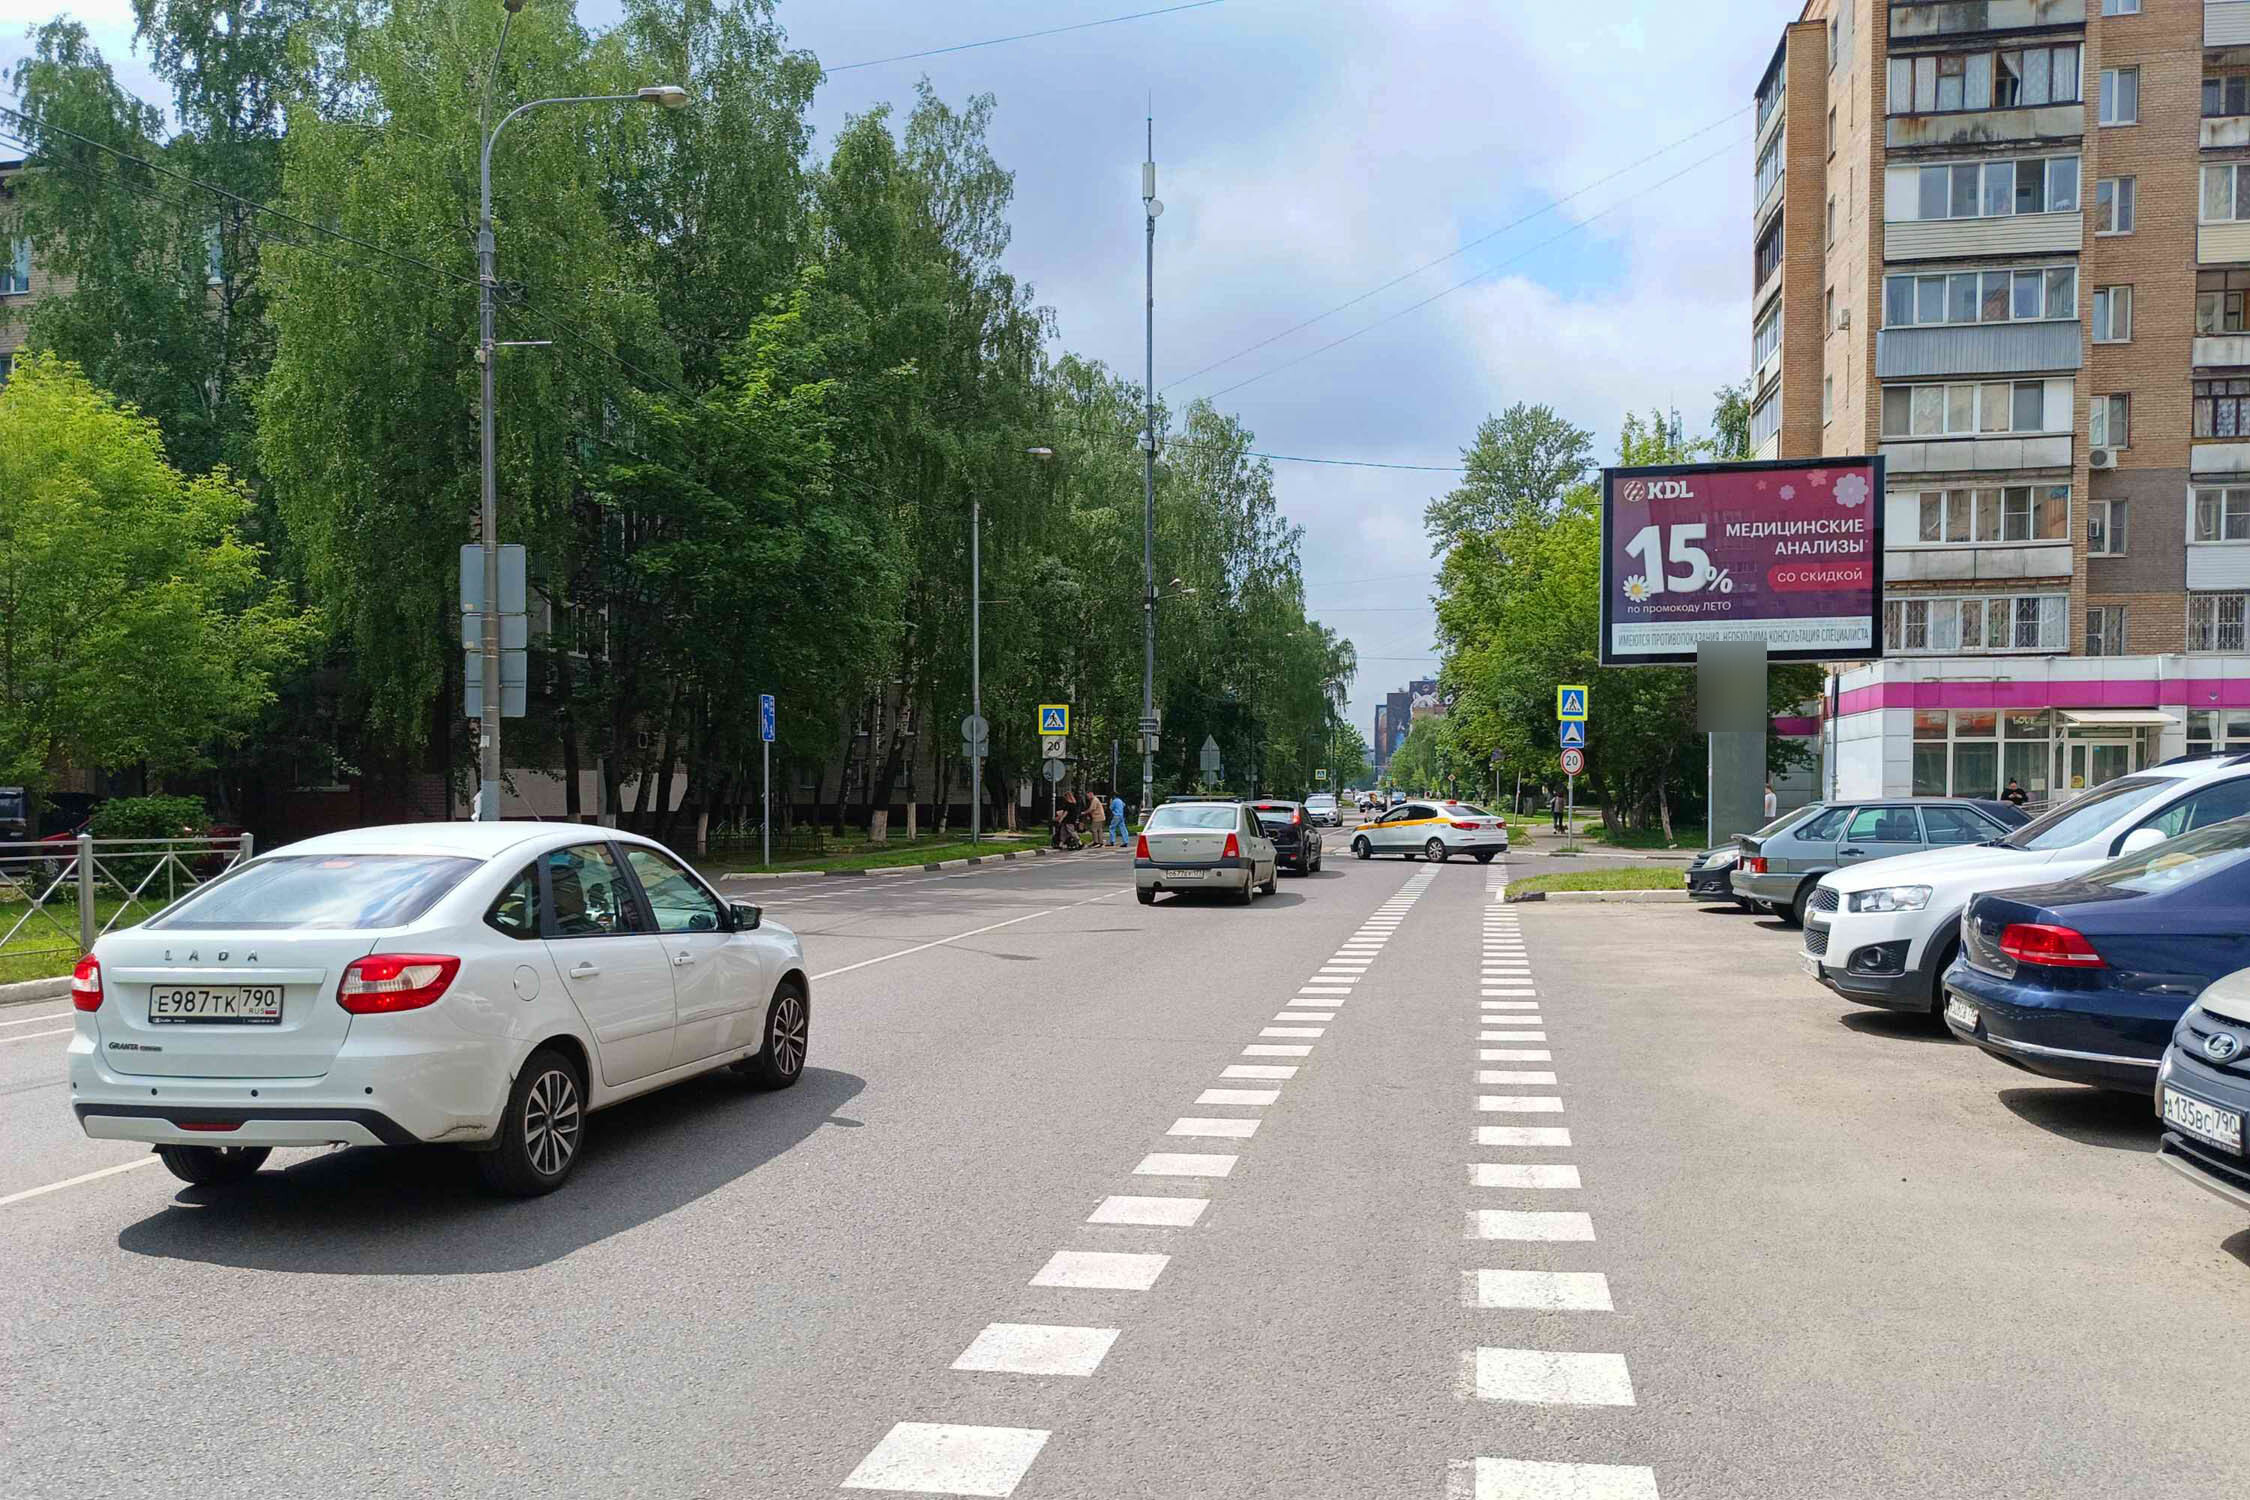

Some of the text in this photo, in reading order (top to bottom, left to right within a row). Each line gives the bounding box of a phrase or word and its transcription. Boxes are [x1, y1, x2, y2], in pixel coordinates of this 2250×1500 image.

[1648, 480, 1694, 500] KDL
[1726, 518, 1865, 538] МЕДИЦИНСКИЕ
[1624, 523, 1733, 594] 15%
[1777, 567, 1863, 583] СО СКИДКОЙ
[1627, 601, 1732, 614] по промокоду ЛЕТО
[1618, 633, 1650, 647] ИМЕЮТСЯ
[1769, 628, 1820, 643] КОНСУЛЬТАЦИЯ
[1821, 627, 1869, 643] СПЕЦИАЛИСТА
[1047, 741, 1061, 751] 20
[1565, 755, 1579, 766] 20
[164, 949, 259, 962] LADA
[157, 989, 275, 1013] Е987ТК 790
[2167, 1096, 2236, 1134] А135ВС 790
